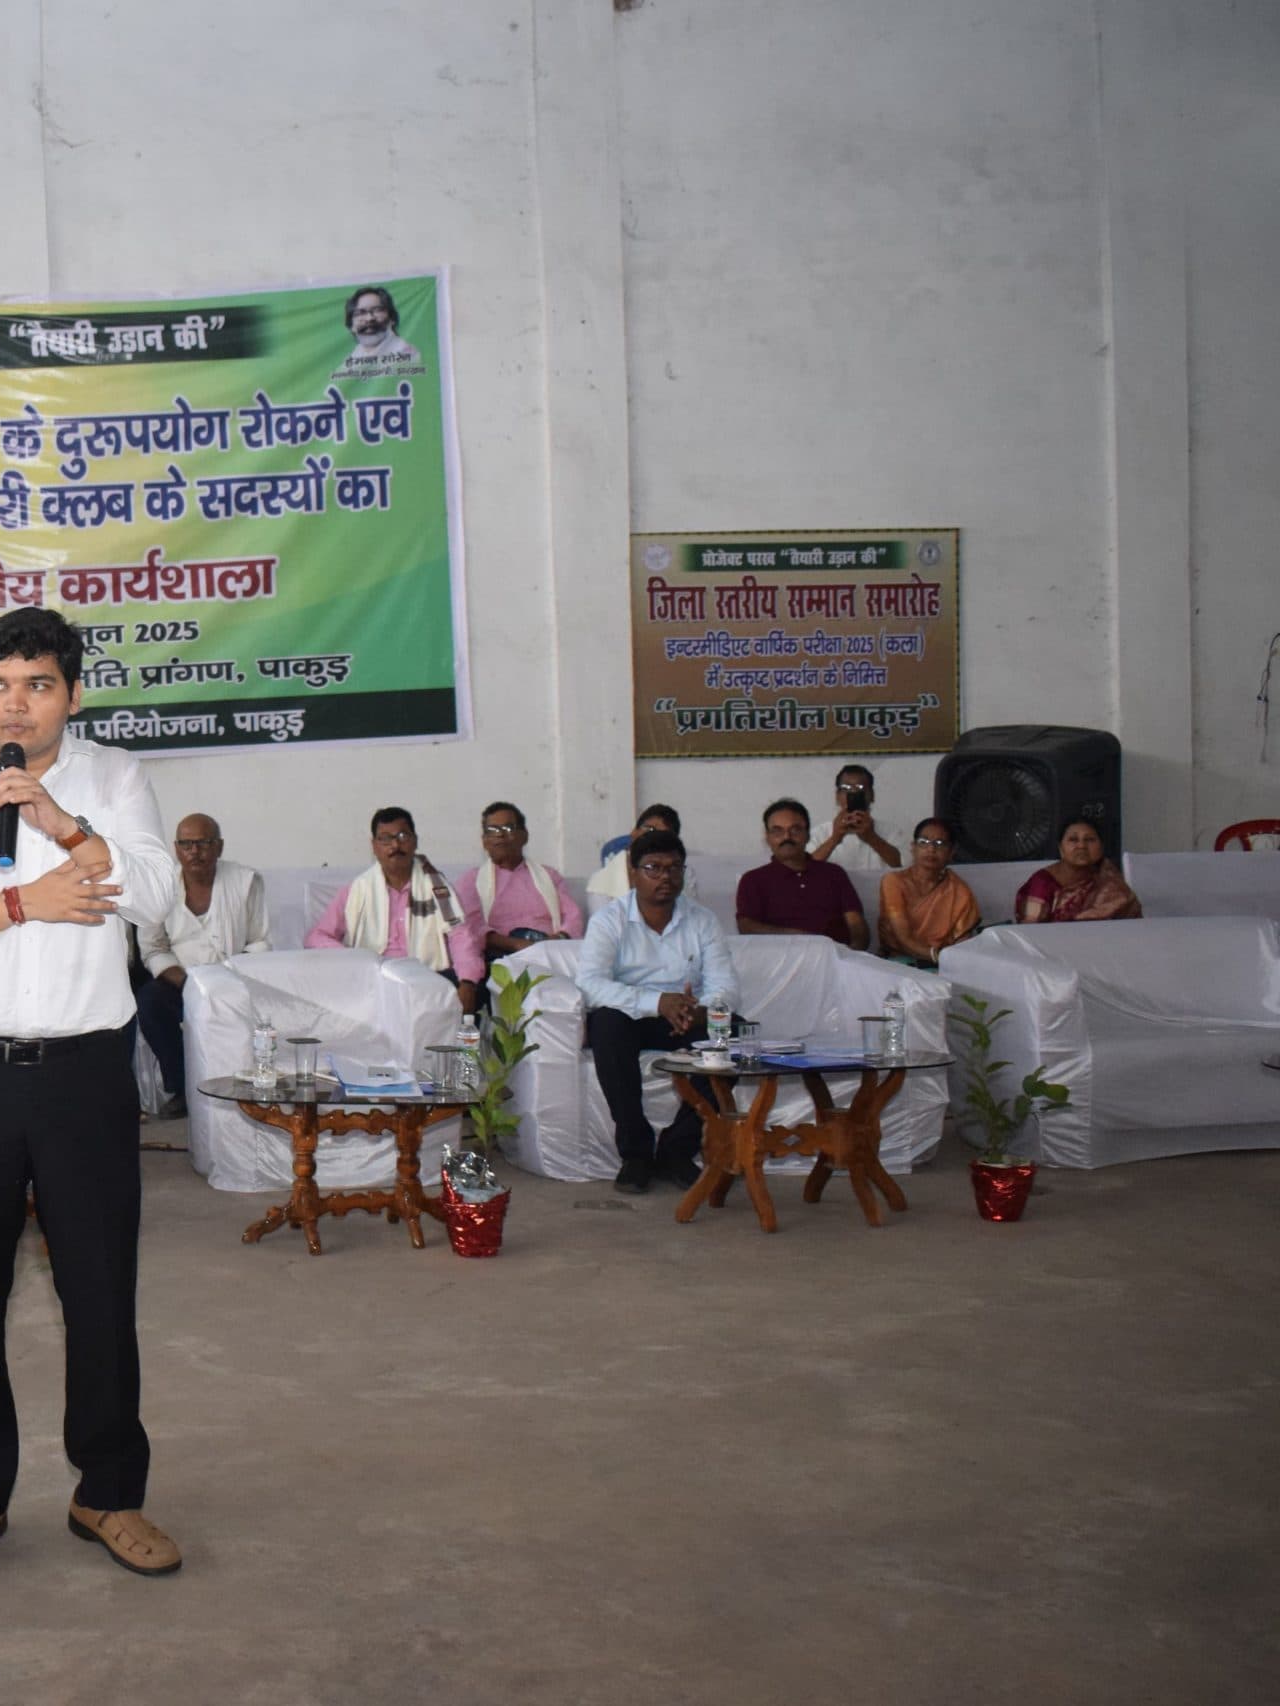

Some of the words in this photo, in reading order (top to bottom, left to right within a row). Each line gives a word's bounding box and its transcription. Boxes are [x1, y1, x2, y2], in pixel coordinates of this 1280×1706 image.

[104, 324, 165, 361] उड़ान
[1, 404, 43, 459] के
[54, 397, 230, 479] दुरूपयोग
[239, 387, 345, 449] रोकने
[354, 382, 413, 444] एवं
[40, 483, 134, 528] क्लब
[144, 465, 186, 519] के
[197, 457, 331, 520] सदस्यों
[335, 467, 392, 511] का
[59, 549, 278, 607] कार्यशाला
[647, 576, 706, 621] जिला
[715, 576, 778, 620] स्तरीय
[786, 584, 856, 620] सम्मान
[865, 573, 940, 618] समारोह
[135, 621, 199, 643] 2025
[754, 630, 798, 655] वार्षिक
[803, 629, 842, 654] परीक्षा
[846, 638, 873, 654] 2025
[139, 657, 246, 688] प्रांगण,
[258, 653, 352, 688] पाकुड़
[705, 664, 720, 688] में
[823, 663, 839, 686] के
[93, 709, 225, 740] परियोजना,
[233, 708, 306, 741] पाकुड़
